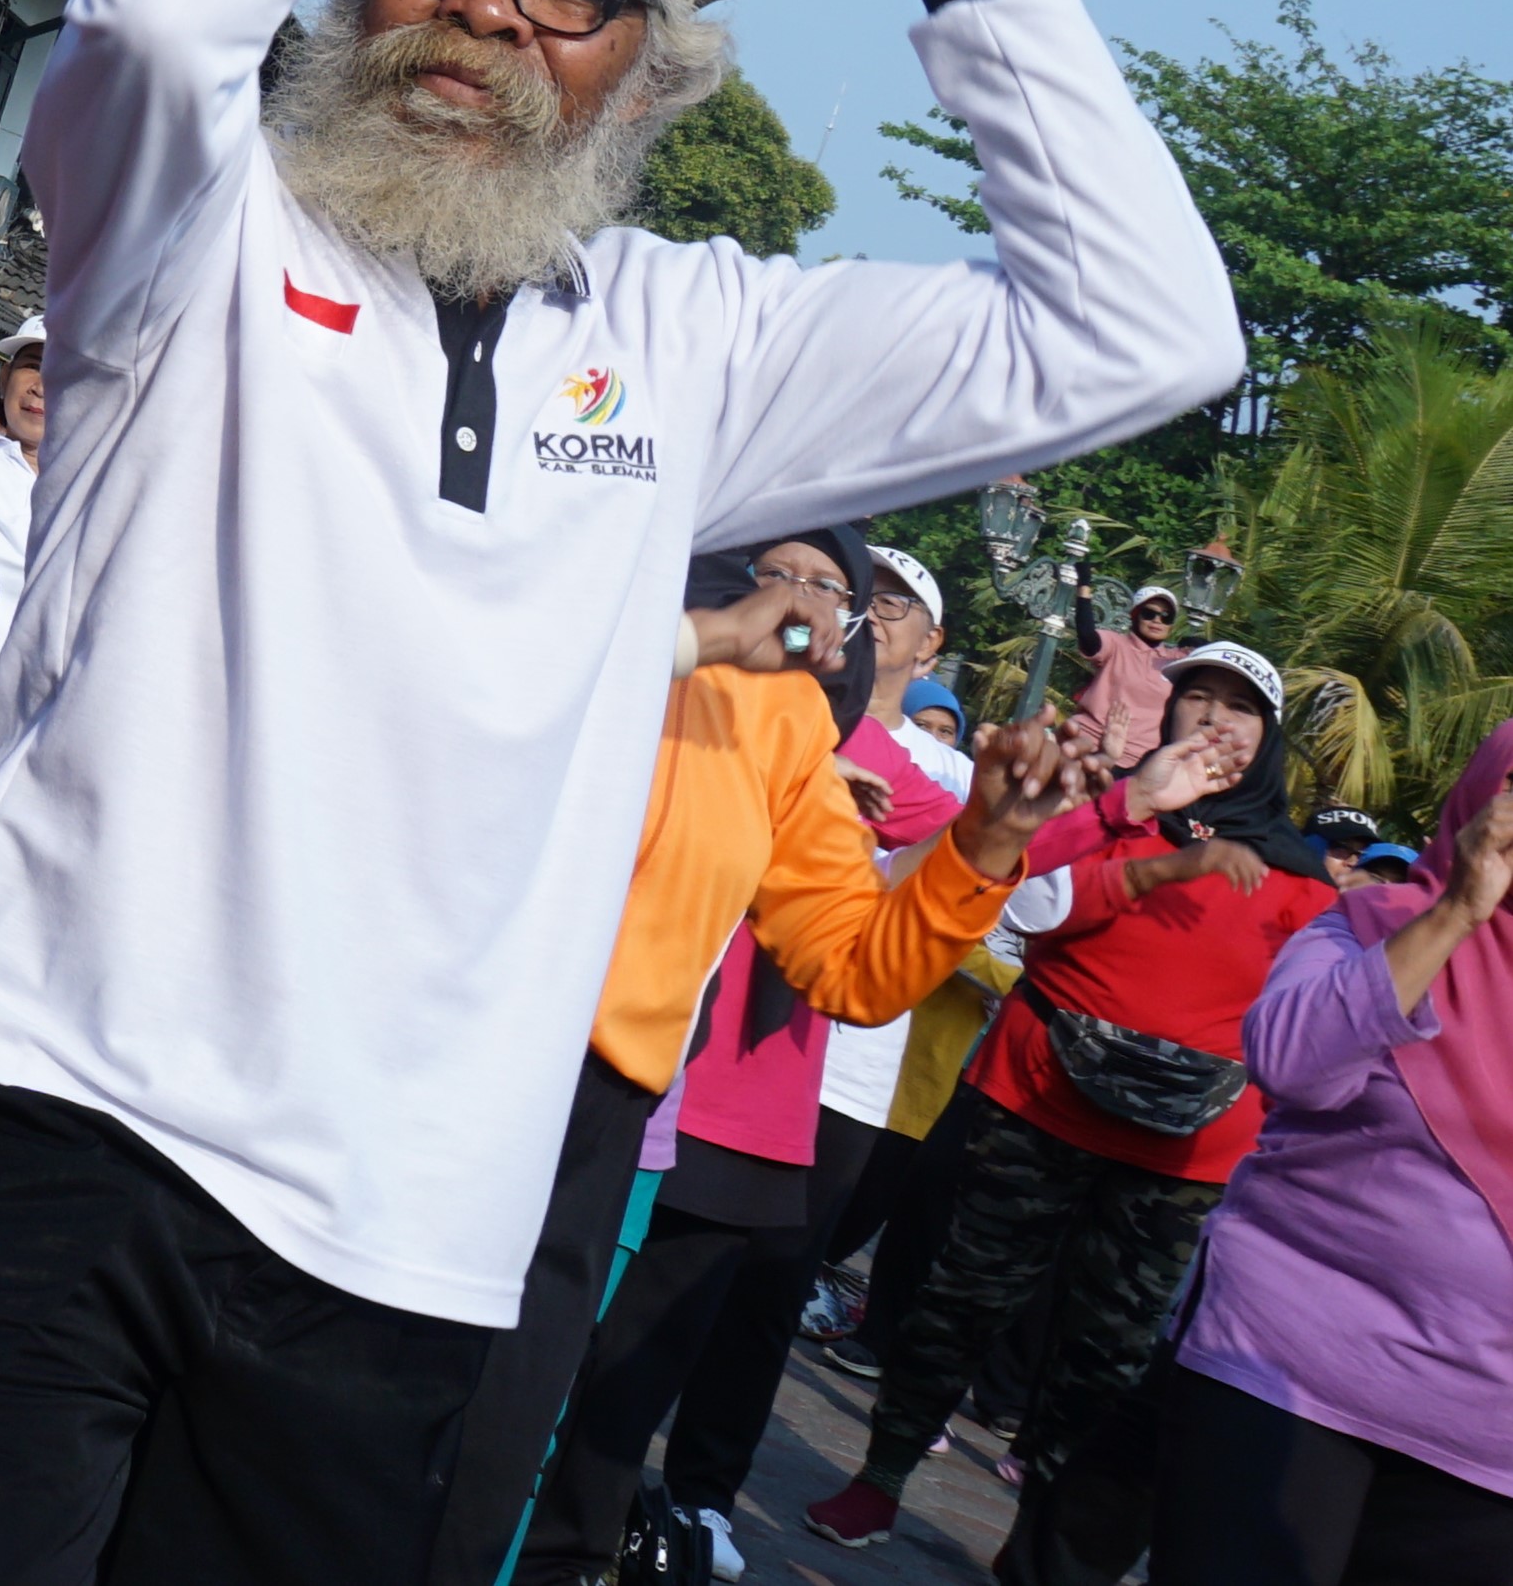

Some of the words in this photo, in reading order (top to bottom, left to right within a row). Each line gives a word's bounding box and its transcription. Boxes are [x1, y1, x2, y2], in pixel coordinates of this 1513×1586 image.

[533, 431, 655, 465] KORMI
[538, 460, 582, 474] KAB.
[591, 464, 657, 484] SLEMAN
